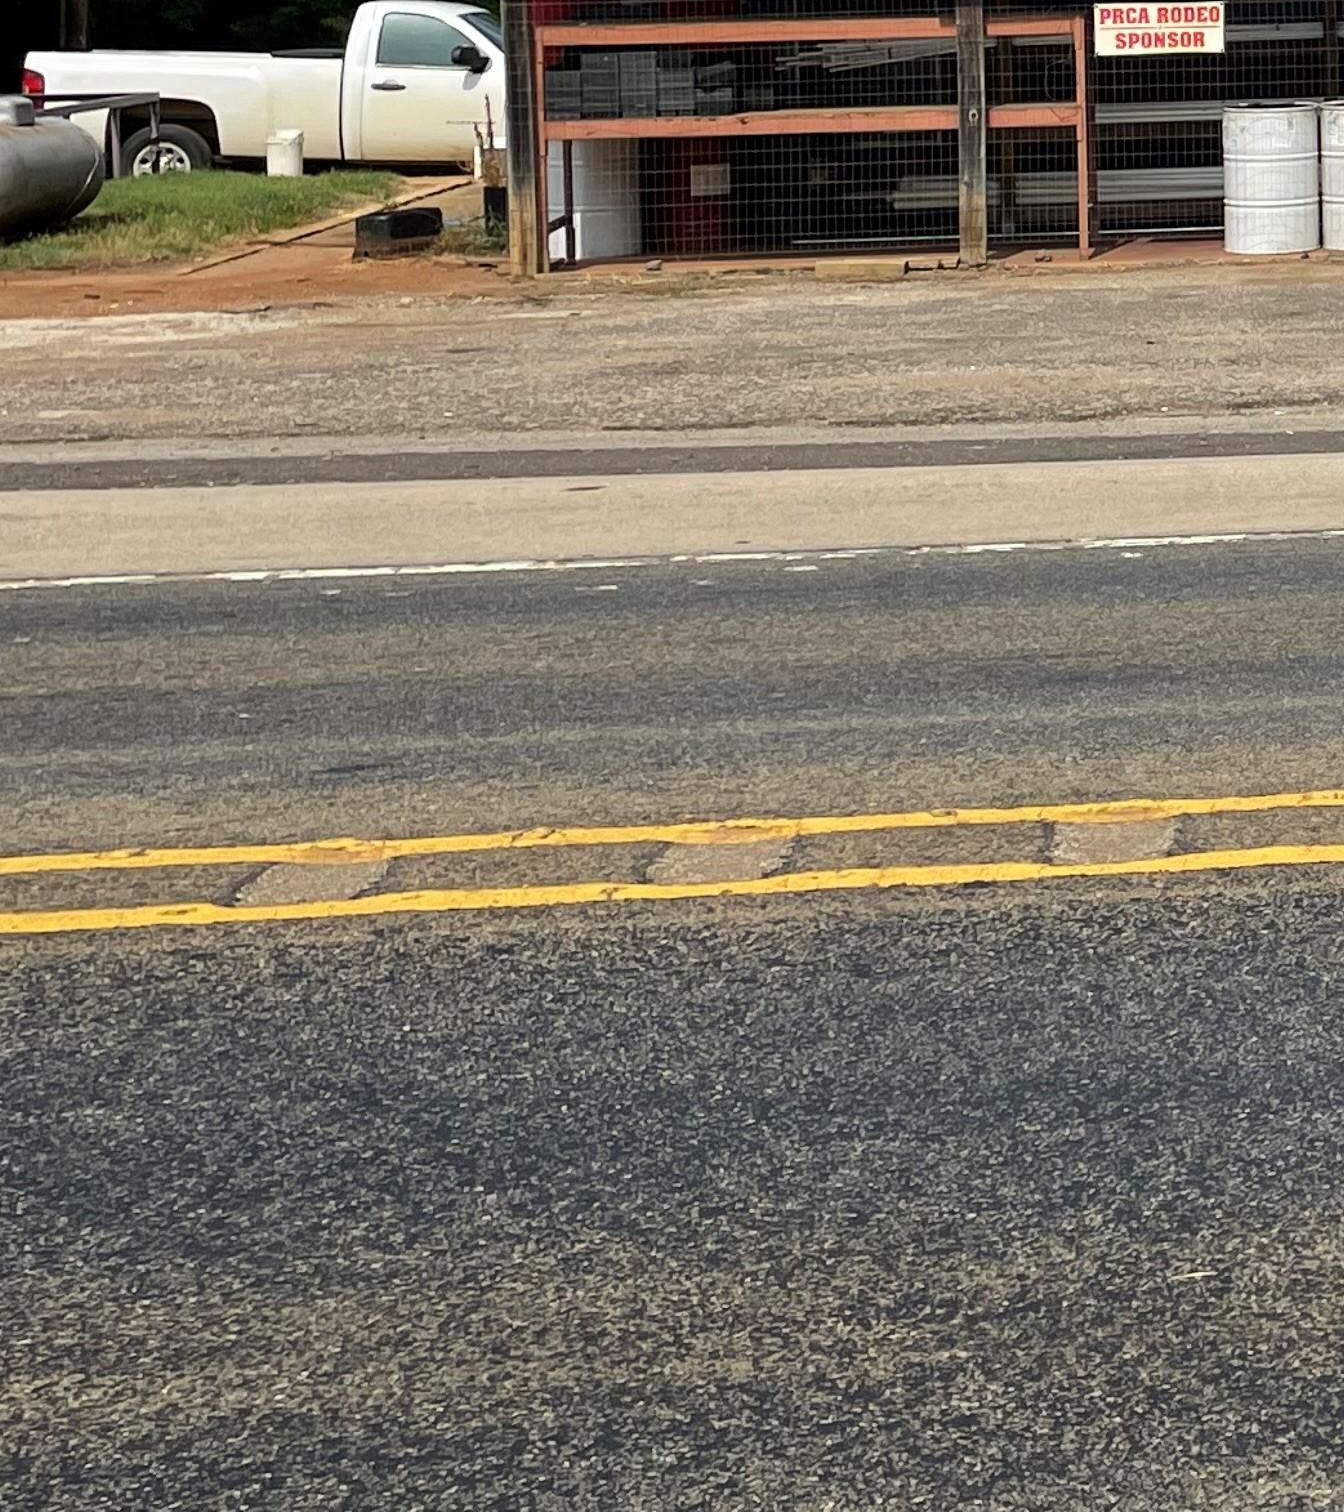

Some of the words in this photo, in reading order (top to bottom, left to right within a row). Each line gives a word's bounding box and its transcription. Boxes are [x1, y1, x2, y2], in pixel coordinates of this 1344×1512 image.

[1099, 7, 1151, 25] PRCA
[1156, 6, 1220, 24] RODEO
[1115, 31, 1206, 49] SPONSOR
